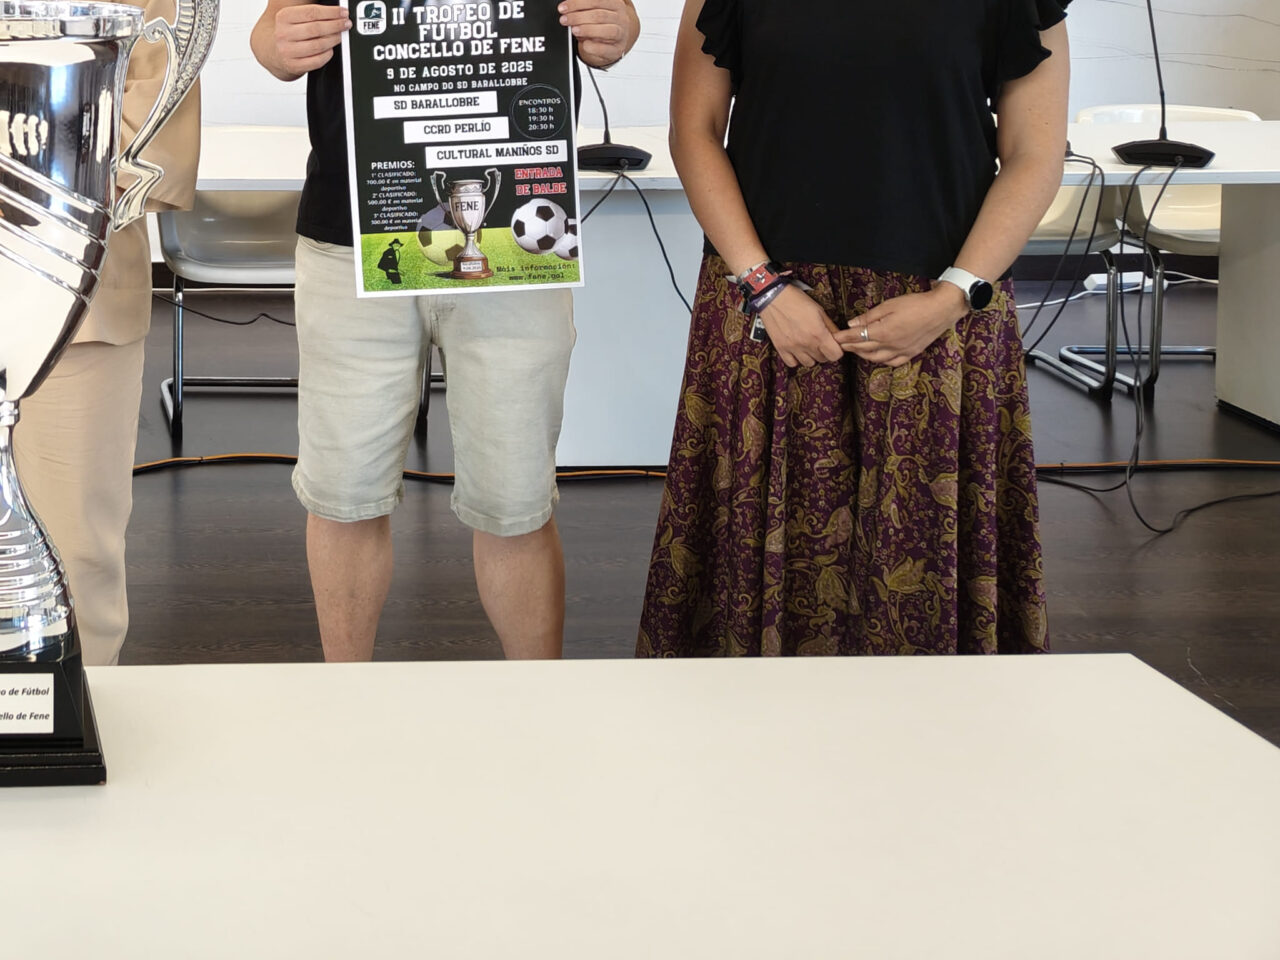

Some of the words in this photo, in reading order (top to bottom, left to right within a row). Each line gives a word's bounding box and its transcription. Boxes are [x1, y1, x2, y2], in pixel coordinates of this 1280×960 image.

[392, 8, 405, 24] II
[413, 3, 491, 23] TROFEO
[499, 1, 524, 19] DE
[364, 22, 379, 30] FENE
[419, 22, 497, 41] FUTBOL
[373, 41, 464, 60] CONCELLO
[471, 40, 493, 55] DE
[500, 37, 545, 53] FENE
[387, 68, 394, 79] 9
[400, 67, 416, 78] DE
[422, 65, 473, 77] AGOSTO
[479, 63, 496, 74] DE
[501, 61, 533, 72] 2025
[394, 84, 405, 92] NO
[409, 83, 438, 91] CAMPO
[457, 81, 468, 89] SD
[471, 78, 527, 88] BARALLOBRE
[394, 100, 408, 110] SD
[411, 97, 479, 109] BARALLOBRE
[519, 97, 561, 106] ENCONTROS
[424, 124, 451, 134] CCRD
[455, 120, 491, 133] PERLÍO
[437, 148, 492, 160] CULTURAL
[496, 145, 542, 157] MANIÑOS
[546, 145, 559, 155] SD
[371, 160, 415, 170] PREMIOS:
[514, 167, 563, 179] ENTRADA
[516, 185, 530, 196] DE
[532, 183, 567, 195] BALDE
[455, 201, 479, 211] FENE
[9, 688, 19, 696] de
[22, 688, 49, 696] Fútbol
